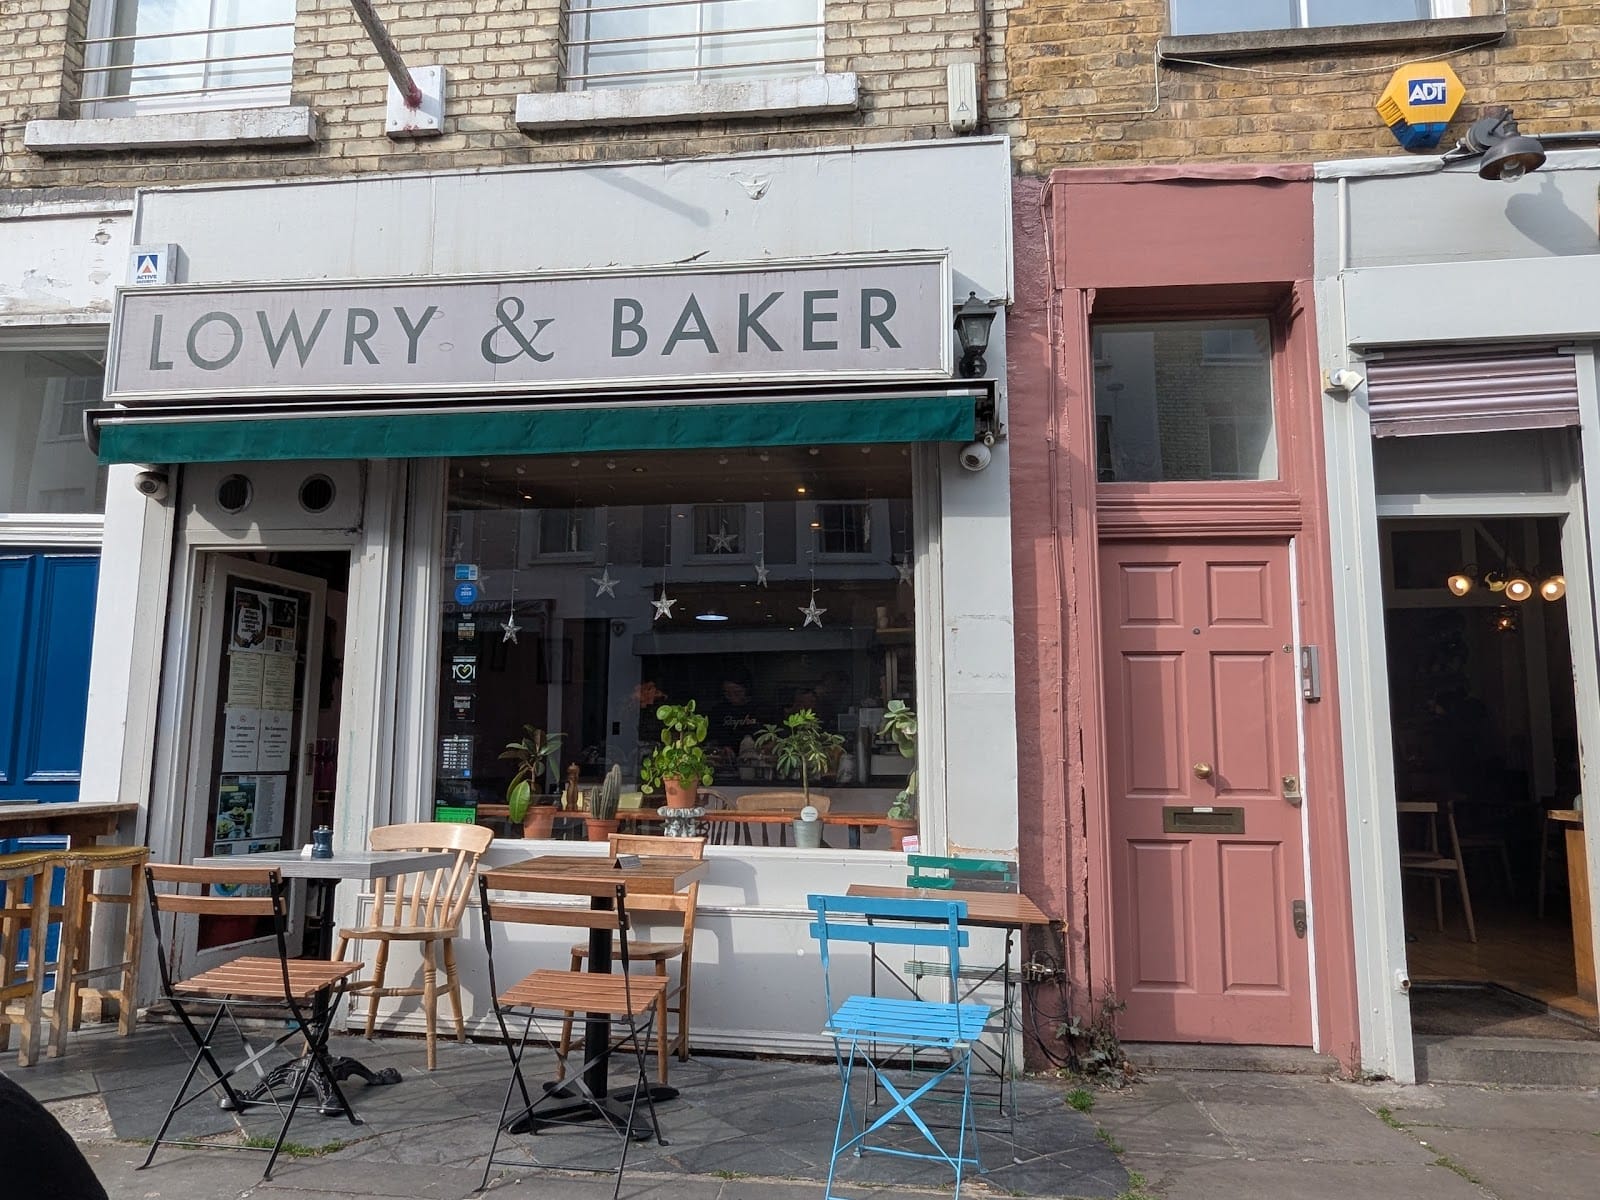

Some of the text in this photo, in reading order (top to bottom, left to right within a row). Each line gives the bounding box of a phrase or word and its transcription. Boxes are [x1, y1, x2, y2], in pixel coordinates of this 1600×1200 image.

[1409, 82, 1446, 102] ADT
[149, 288, 902, 371] LOWRY & BAKER
